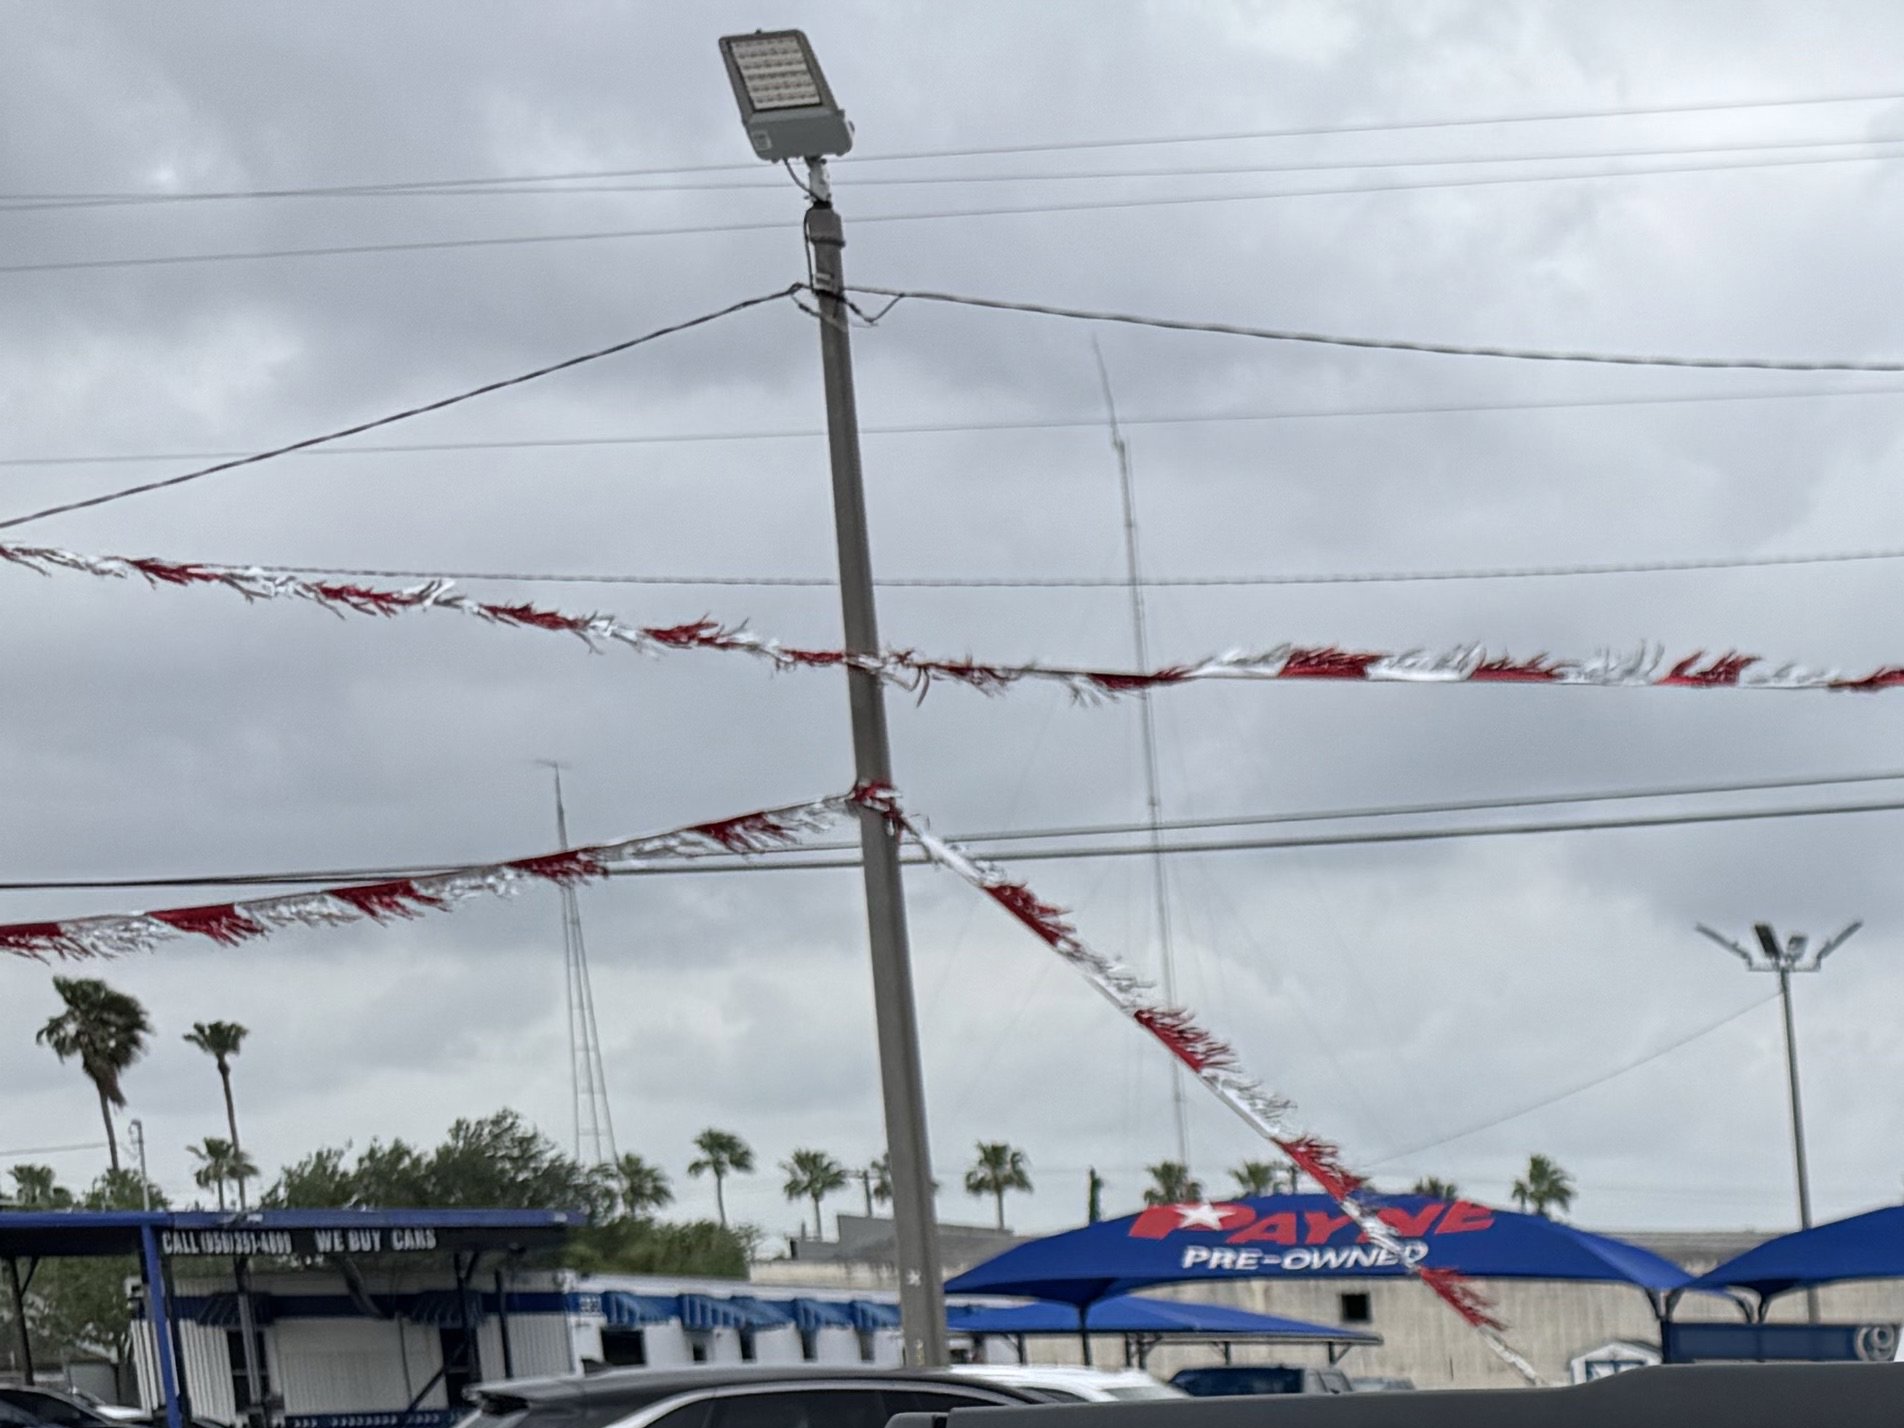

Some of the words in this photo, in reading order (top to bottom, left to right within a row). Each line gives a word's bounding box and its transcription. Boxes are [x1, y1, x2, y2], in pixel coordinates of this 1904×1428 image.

[1128, 1199, 1496, 1245] PAYNE
[162, 1230, 199, 1254] CALL
[315, 1229, 345, 1252] WE
[350, 1229, 381, 1251] BUY
[391, 1229, 437, 1250] CARS
[1182, 1241, 1429, 1271] PRE-OWNED
